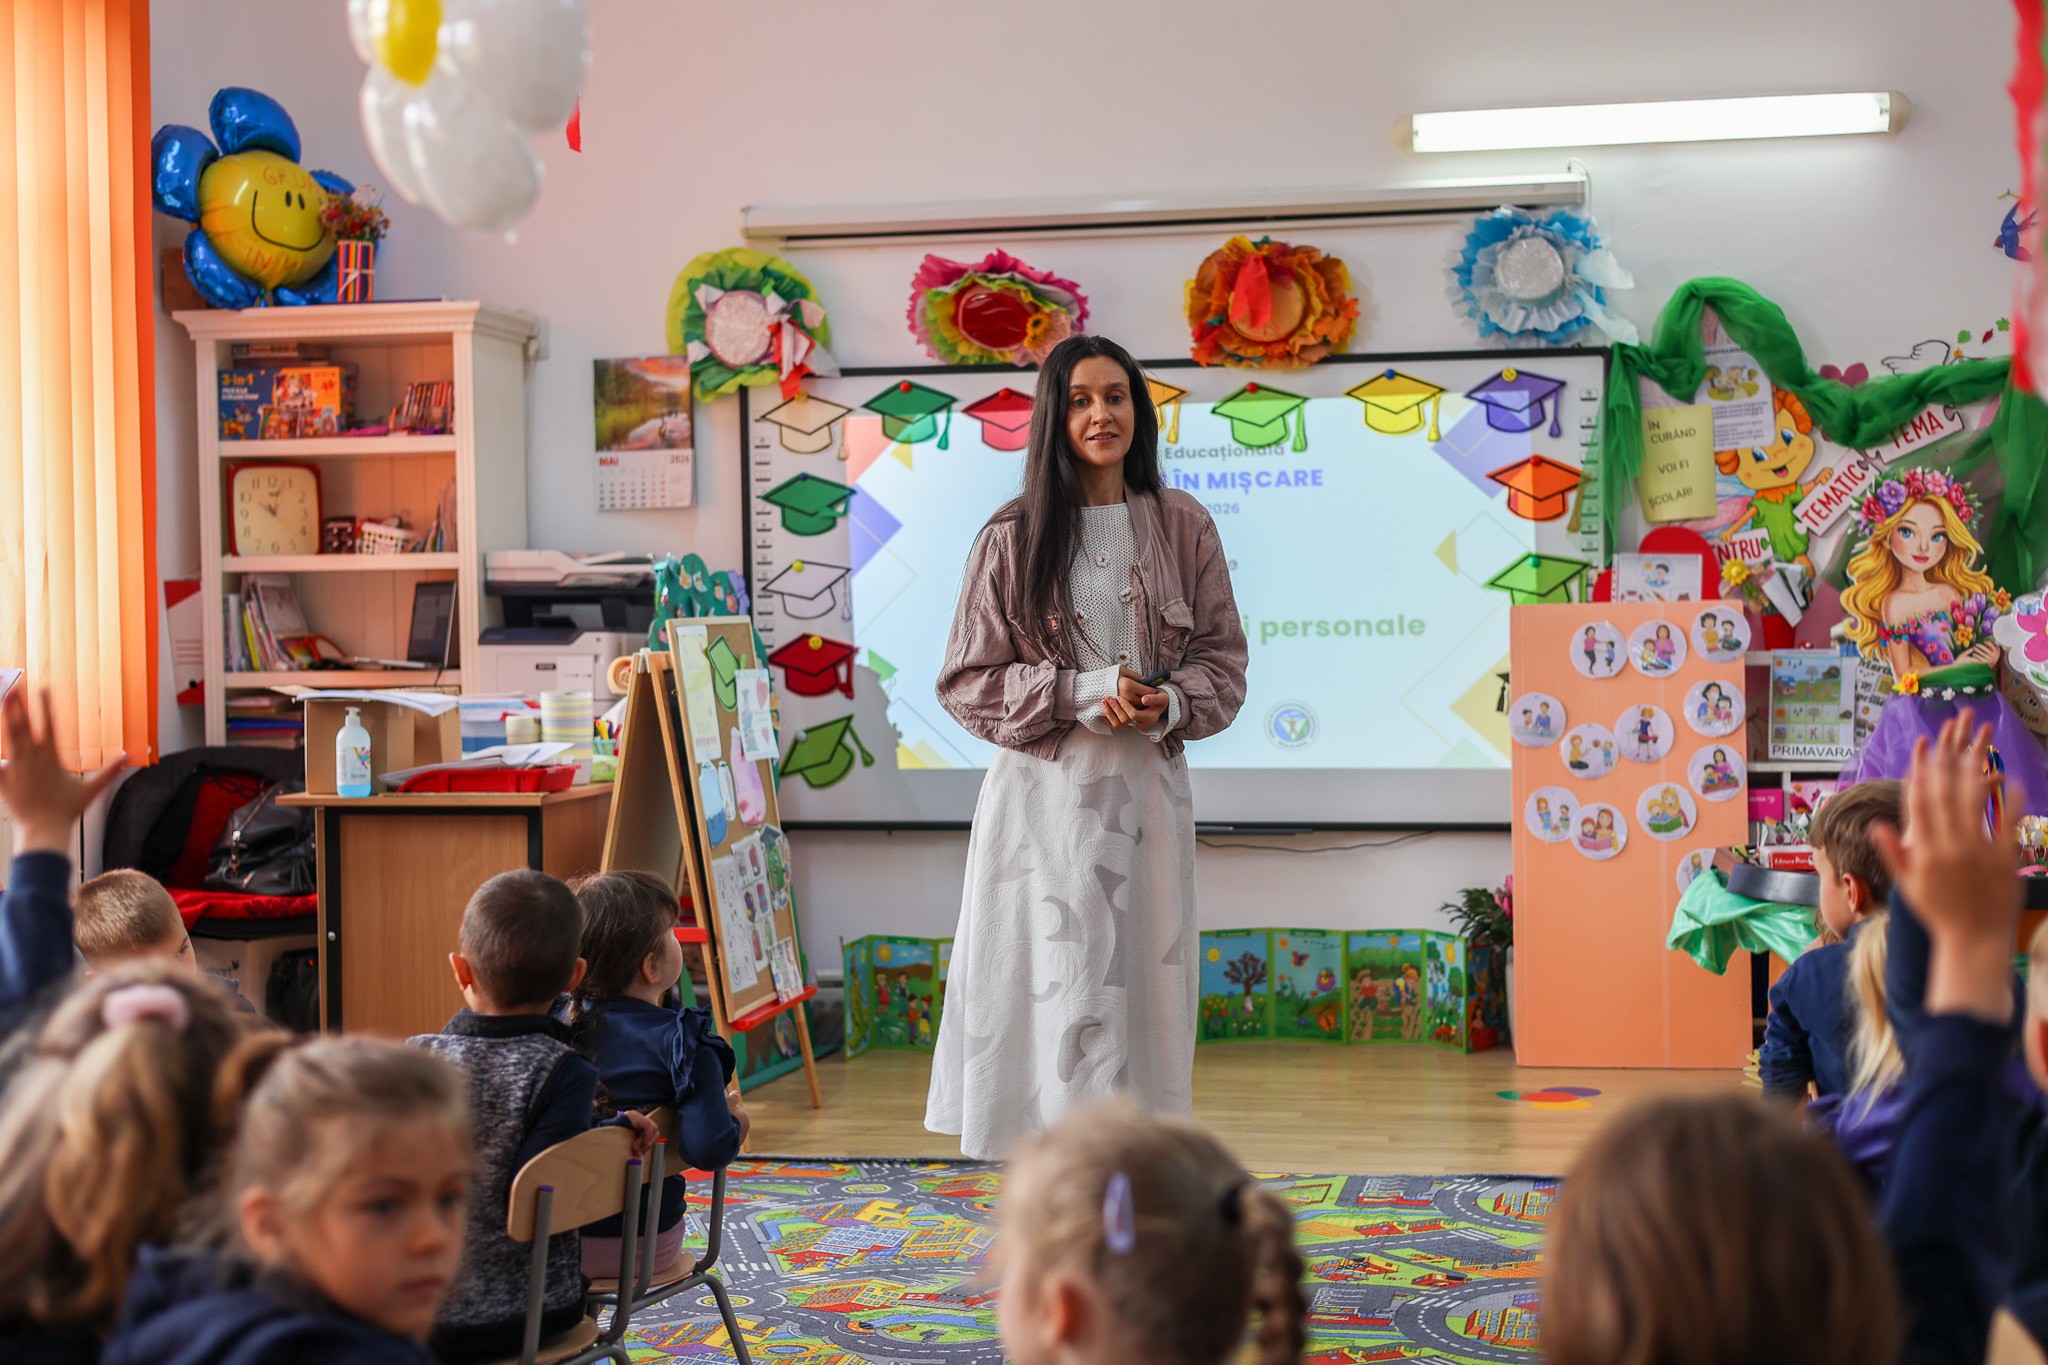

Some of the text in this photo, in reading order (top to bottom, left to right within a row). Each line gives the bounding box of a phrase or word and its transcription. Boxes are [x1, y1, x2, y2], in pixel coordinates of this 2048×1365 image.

[599, 455, 619, 466] MAI
[1164, 442, 1286, 462] Educațională
[1657, 462, 1678, 475] VOI
[1173, 467, 1201, 490] ÎN
[1206, 469, 1324, 496] MIȘCARE
[1801, 464, 1866, 528] TEMATIC
[1260, 614, 1426, 645] personale
[1772, 745, 1854, 757] PRIMAVARA
